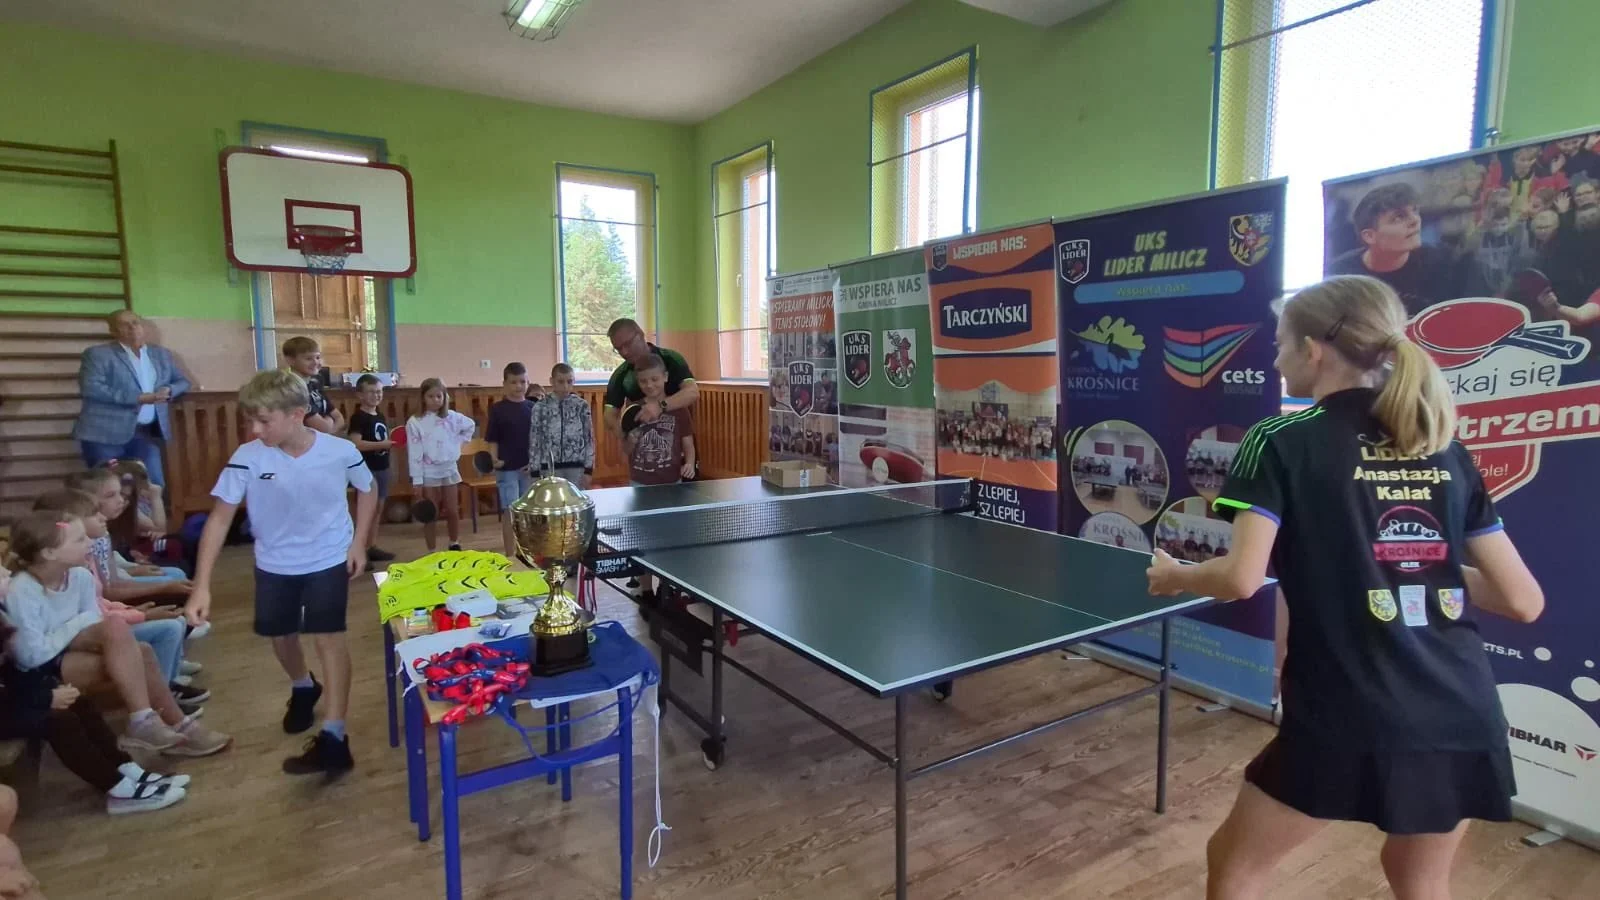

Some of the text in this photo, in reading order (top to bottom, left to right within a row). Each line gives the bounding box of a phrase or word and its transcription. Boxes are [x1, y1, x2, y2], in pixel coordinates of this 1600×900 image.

[952, 236, 1028, 260] WSPIERA NAS:
[1065, 242, 1084, 251] UKS
[1134, 231, 1168, 251] UKS
[1062, 249, 1087, 260] LIDER
[1104, 249, 1209, 276] LIDER MILICZ
[849, 281, 895, 300] WSPIERA
[897, 277, 922, 293] NAS
[943, 302, 1027, 329] TARCZYŃSKI
[848, 333, 867, 345] UKS
[845, 344, 870, 356] LIDER
[793, 364, 810, 375] UKS
[1222, 367, 1266, 385] cets
[1509, 361, 1556, 387] się
[790, 374, 812, 385] LIDER
[1067, 372, 1141, 392] KROŚNICE
[1456, 403, 1600, 440] trzem
[1353, 465, 1452, 484] Anastazja
[1480, 463, 1509, 478] ole!
[1376, 486, 1432, 501] Kalat
[992, 503, 1025, 524] LEPIEJ
[596, 557, 627, 568] TIBHAR
[1482, 642, 1524, 660] ETS.PL
[1509, 726, 1567, 754] IBHAR
